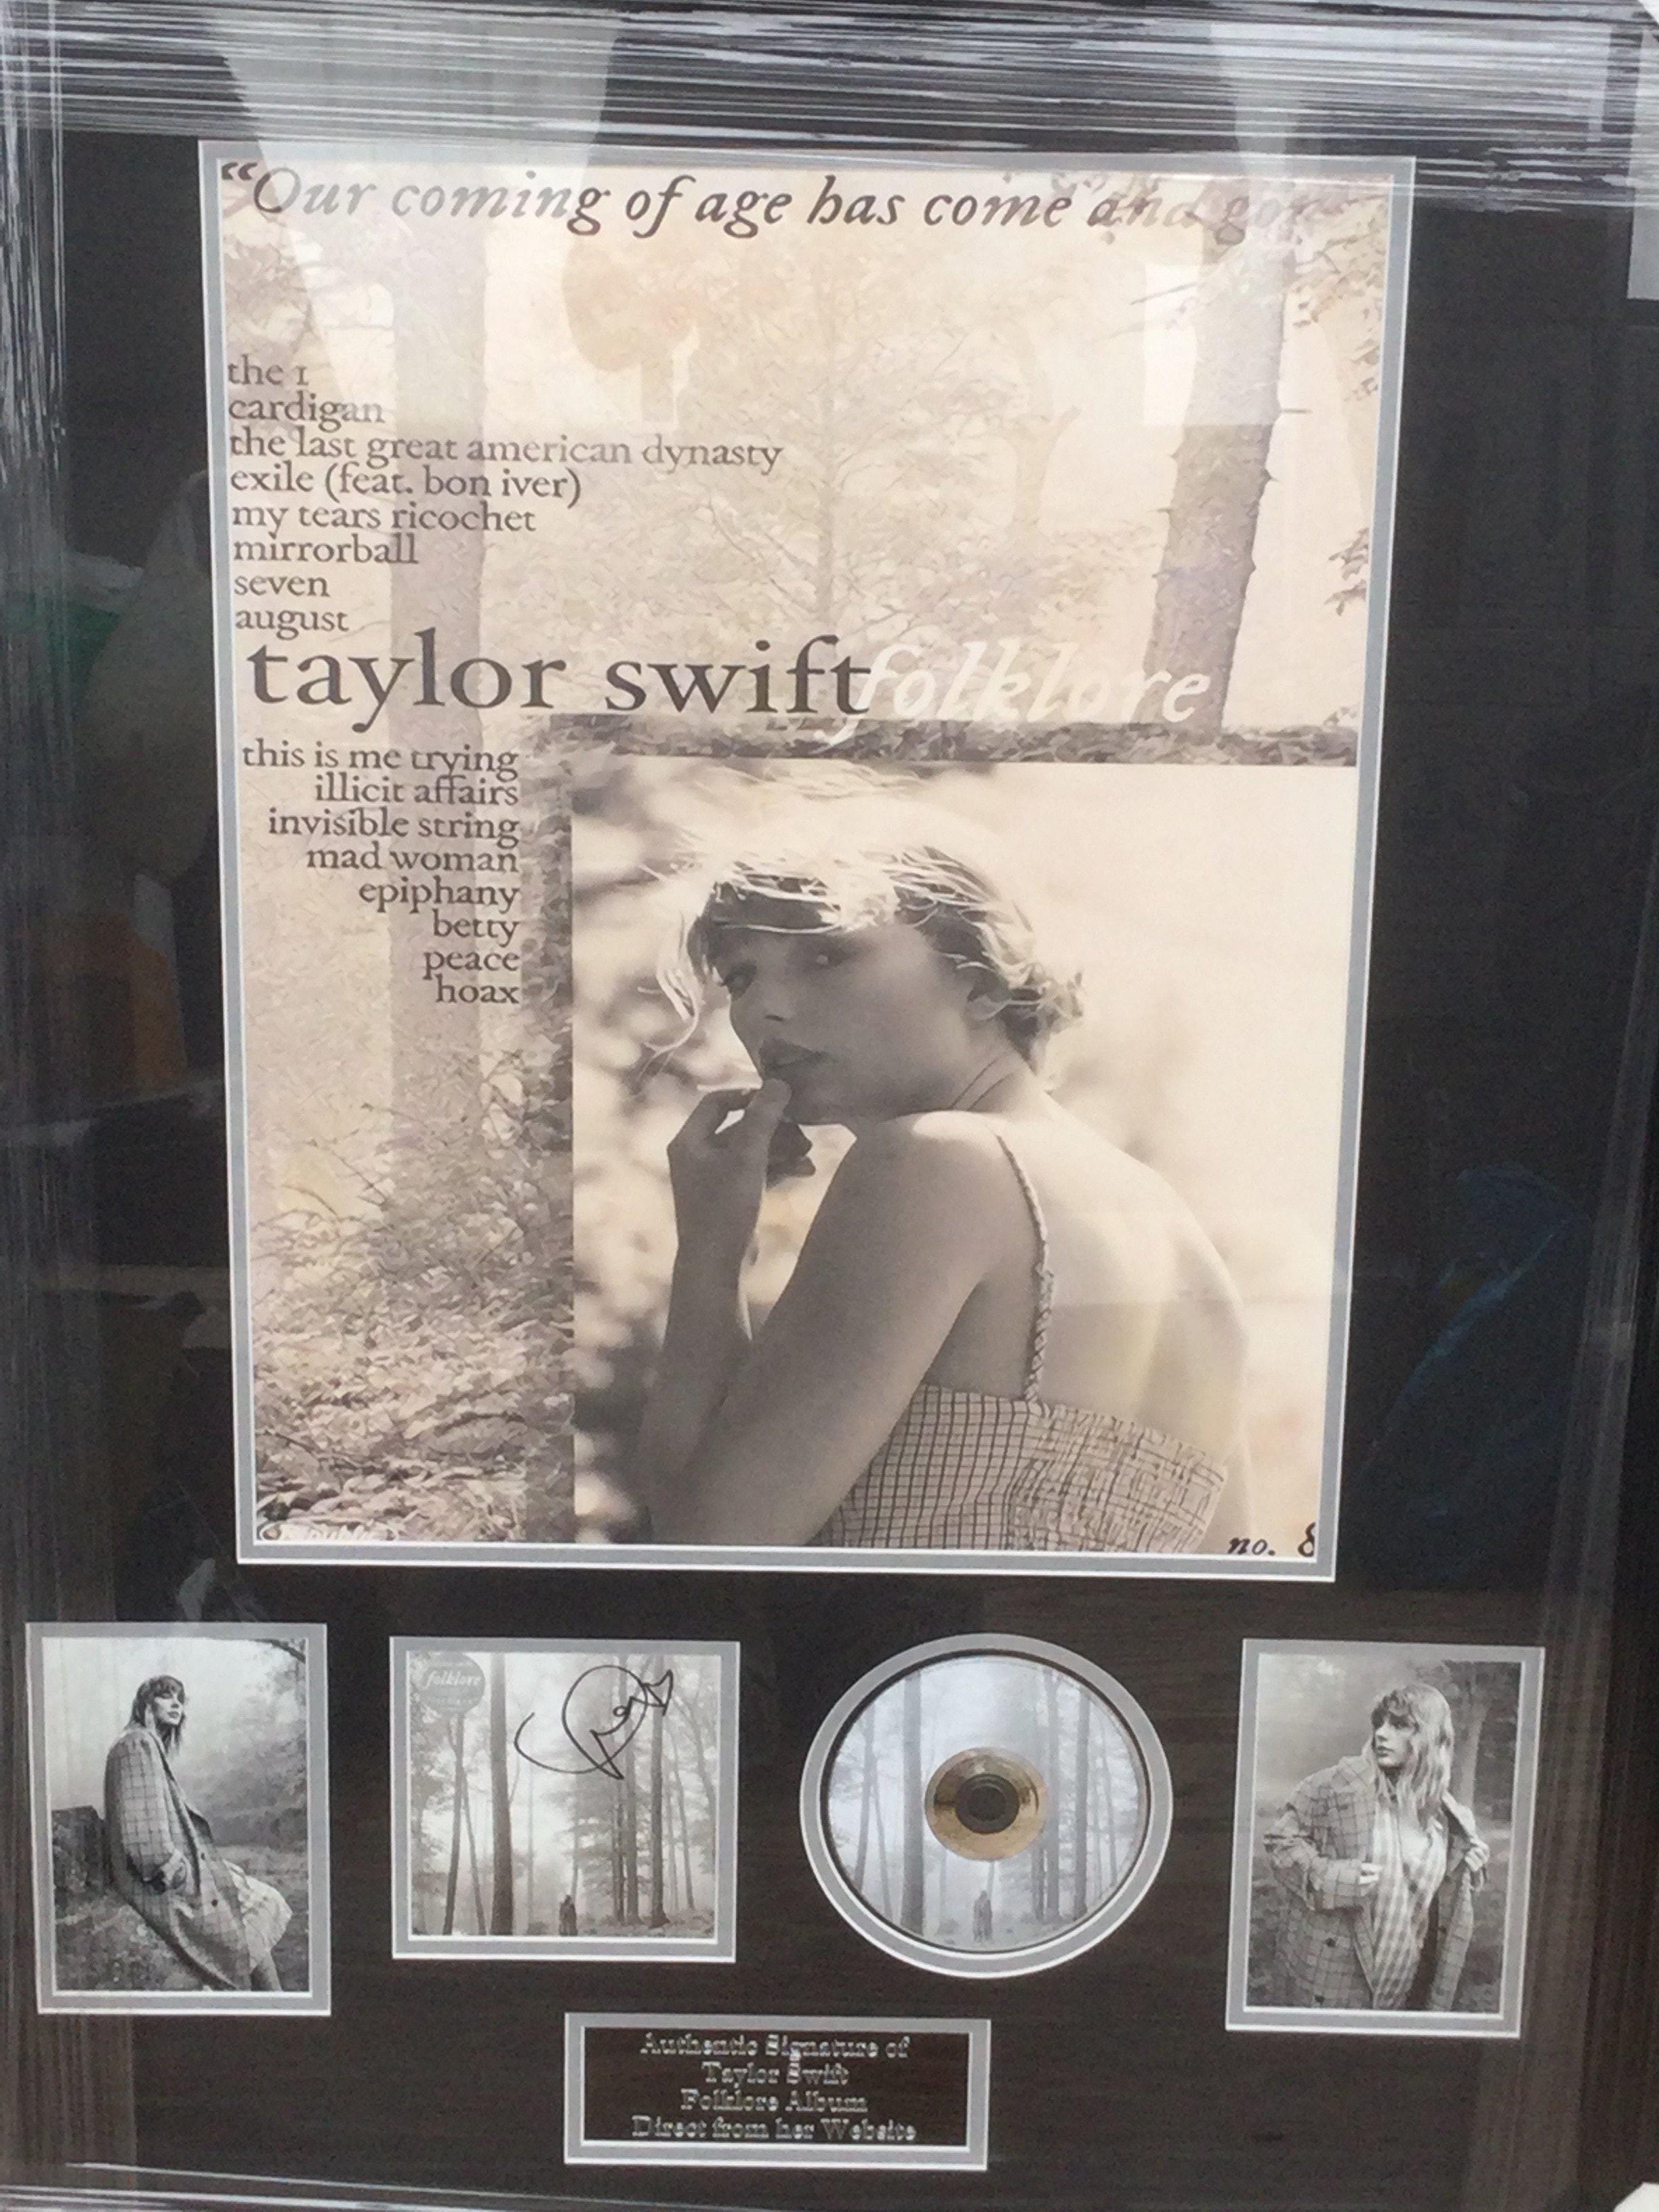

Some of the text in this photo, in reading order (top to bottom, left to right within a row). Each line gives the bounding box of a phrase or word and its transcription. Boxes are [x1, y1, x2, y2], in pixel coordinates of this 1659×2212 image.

[391, 169, 612, 237] coming
[625, 174, 697, 239] of
[695, 190, 793, 239] age
[806, 174, 905, 225] has
[923, 194, 1071, 228] come
[228, 354, 283, 385] the
[228, 391, 385, 433] cardigan
[230, 426, 783, 476] the last great american dynasty
[230, 459, 581, 508] exile (feat. bon iver)
[231, 500, 536, 539] my tears ricochet
[232, 532, 419, 565] mirrorball
[234, 573, 330, 596] seven
[234, 607, 349, 641] august
[247, 626, 1211, 746] taylor swift folklore
[243, 738, 519, 782] this is me trying
[315, 772, 518, 805] illicit affairs
[268, 807, 519, 849] invisible string
[307, 840, 518, 872] mad woman
[359, 876, 519, 914] epiphany
[432, 909, 519, 947] betty
[422, 951, 520, 980] peace
[436, 974, 519, 1004] hoax
[1227, 1537, 1275, 1556] no.
[886, 2036, 911, 2058] of
[712, 2116, 769, 2139] from
[775, 2116, 815, 2139] her
